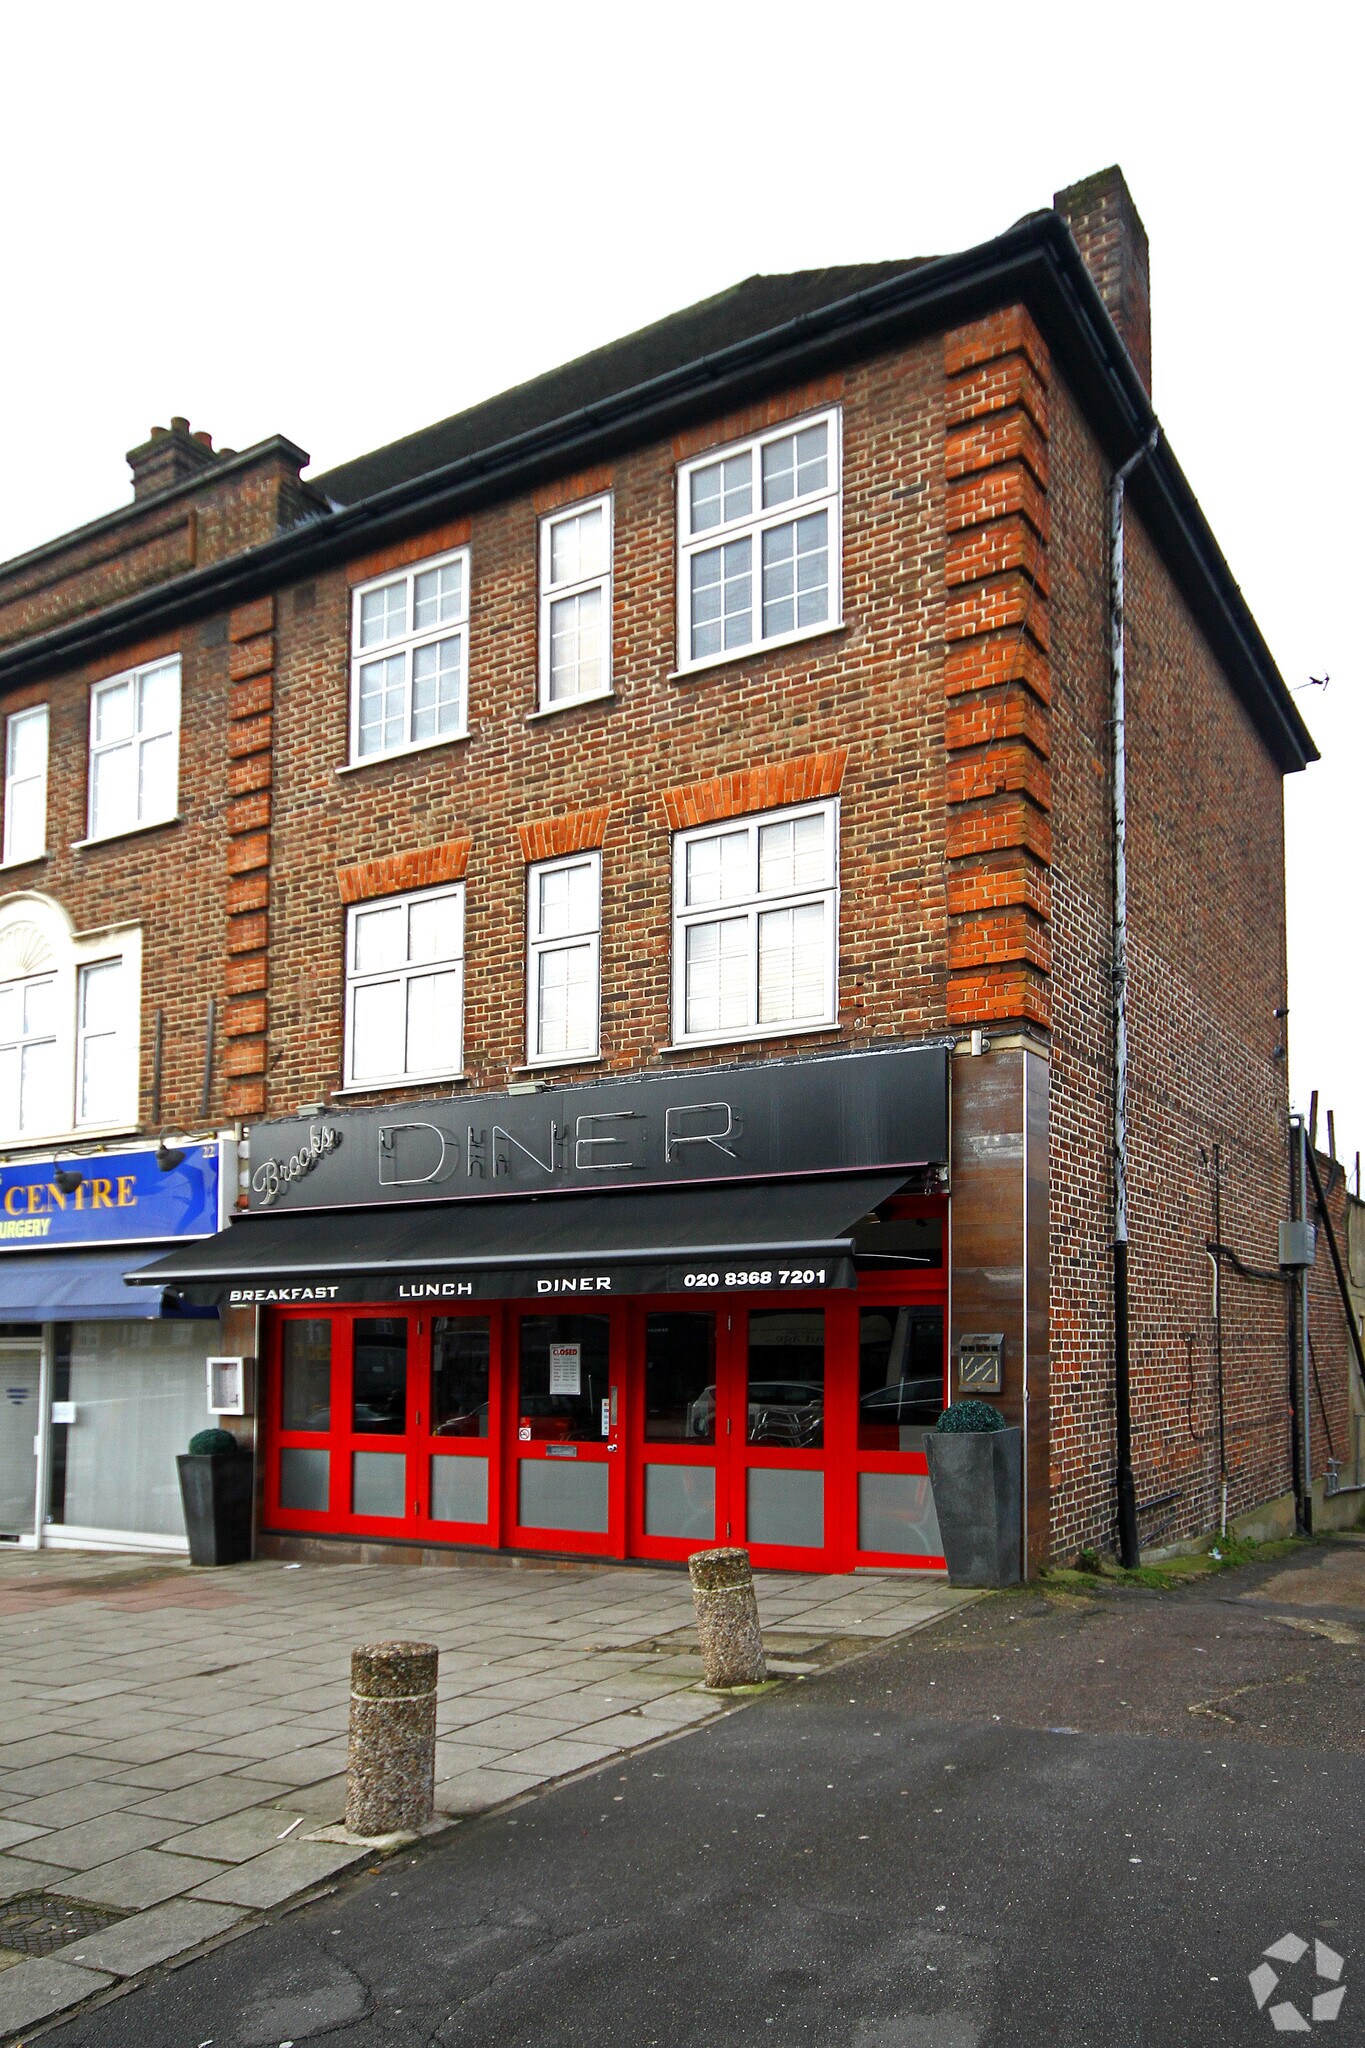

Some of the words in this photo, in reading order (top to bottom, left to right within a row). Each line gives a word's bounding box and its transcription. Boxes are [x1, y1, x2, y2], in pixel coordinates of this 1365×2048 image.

[202, 1146, 216, 1159] 22
[379, 1102, 737, 1186] DINER
[4, 1175, 138, 1216] CENTRE
[229, 1286, 339, 1302] BREAKFAST
[399, 1282, 473, 1297] LUNCH
[537, 1276, 612, 1293] DINER
[684, 1274, 719, 1287] 020
[725, 1271, 772, 1285] 8368
[778, 1270, 826, 1284] 7201
